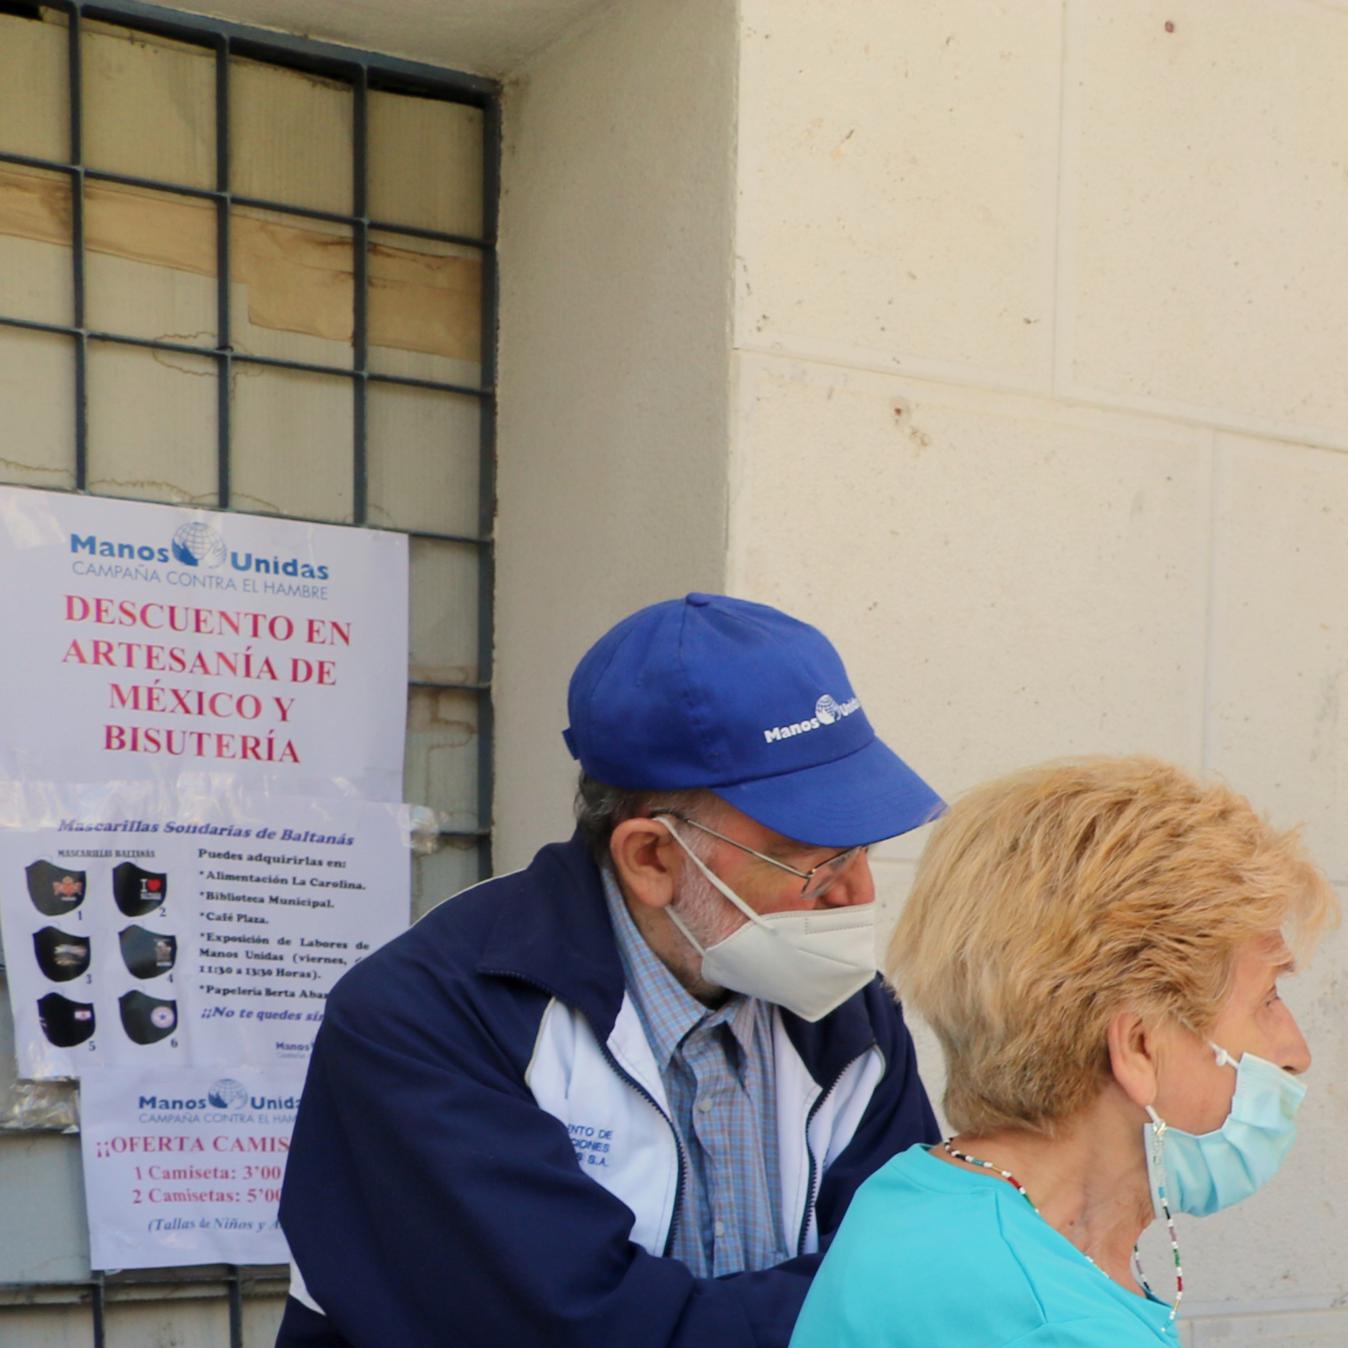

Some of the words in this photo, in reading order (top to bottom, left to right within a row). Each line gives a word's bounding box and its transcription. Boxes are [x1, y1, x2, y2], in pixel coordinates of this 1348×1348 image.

[70, 533, 168, 563] Manos
[230, 552, 330, 580] Unidas
[72, 561, 161, 583] CAMPAÑA
[167, 571, 236, 591] CONTRA
[243, 578, 258, 593] EL
[264, 582, 328, 600] HAMBRE
[64, 594, 294, 641] DESCUENTO
[305, 619, 352, 647] EN
[62, 639, 278, 681] ARTESANÍA
[290, 659, 337, 686] DE
[109, 679, 262, 720] MÉXICO
[273, 697, 295, 722] Y
[764, 717, 820, 743] Manos
[104, 725, 301, 764] BISUTERÍA
[58, 819, 158, 833] Mascarillas
[256, 828, 276, 840] de
[281, 829, 354, 846] Baltanás
[198, 849, 242, 861] Puedes
[247, 854, 323, 867] adquirirlas
[327, 859, 346, 868] en:
[206, 871, 288, 884] Alimentación
[292, 877, 306, 886] La
[310, 878, 366, 890] Carolina.
[206, 892, 264, 904] Biblioteca
[269, 895, 335, 908] Municipal.
[159, 908, 166, 916] 2
[206, 912, 233, 922] Café
[237, 914, 268, 924] Plaza.
[207, 932, 269, 945] Exposición
[278, 937, 291, 945] de
[300, 938, 347, 949] Labores
[356, 941, 369, 950] de
[200, 949, 238, 958] Manos
[245, 950, 283, 961] Unidas
[293, 953, 347, 965] (viernes,
[276, 968, 321, 979] Horas).
[206, 985, 262, 997] Papelería
[265, 988, 295, 997] Berta
[240, 1007, 253, 1018] te
[257, 1010, 301, 1021] quedes
[89, 1041, 95, 1050] 5
[171, 1039, 178, 1048] 6
[139, 1096, 206, 1109] Manos
[139, 1112, 199, 1124] CAMPAÑA
[204, 1113, 253, 1123] CONTRA
[258, 1114, 269, 1123] EL
[135, 1167, 142, 1180] 1
[149, 1167, 236, 1180] Camiseta:
[133, 1189, 142, 1204] 2
[149, 1188, 239, 1203] Camisetas:
[148, 1219, 195, 1232] (Tallas
[199, 1220, 210, 1229] de
[213, 1218, 252, 1230] Niños
[257, 1222, 265, 1233] y
